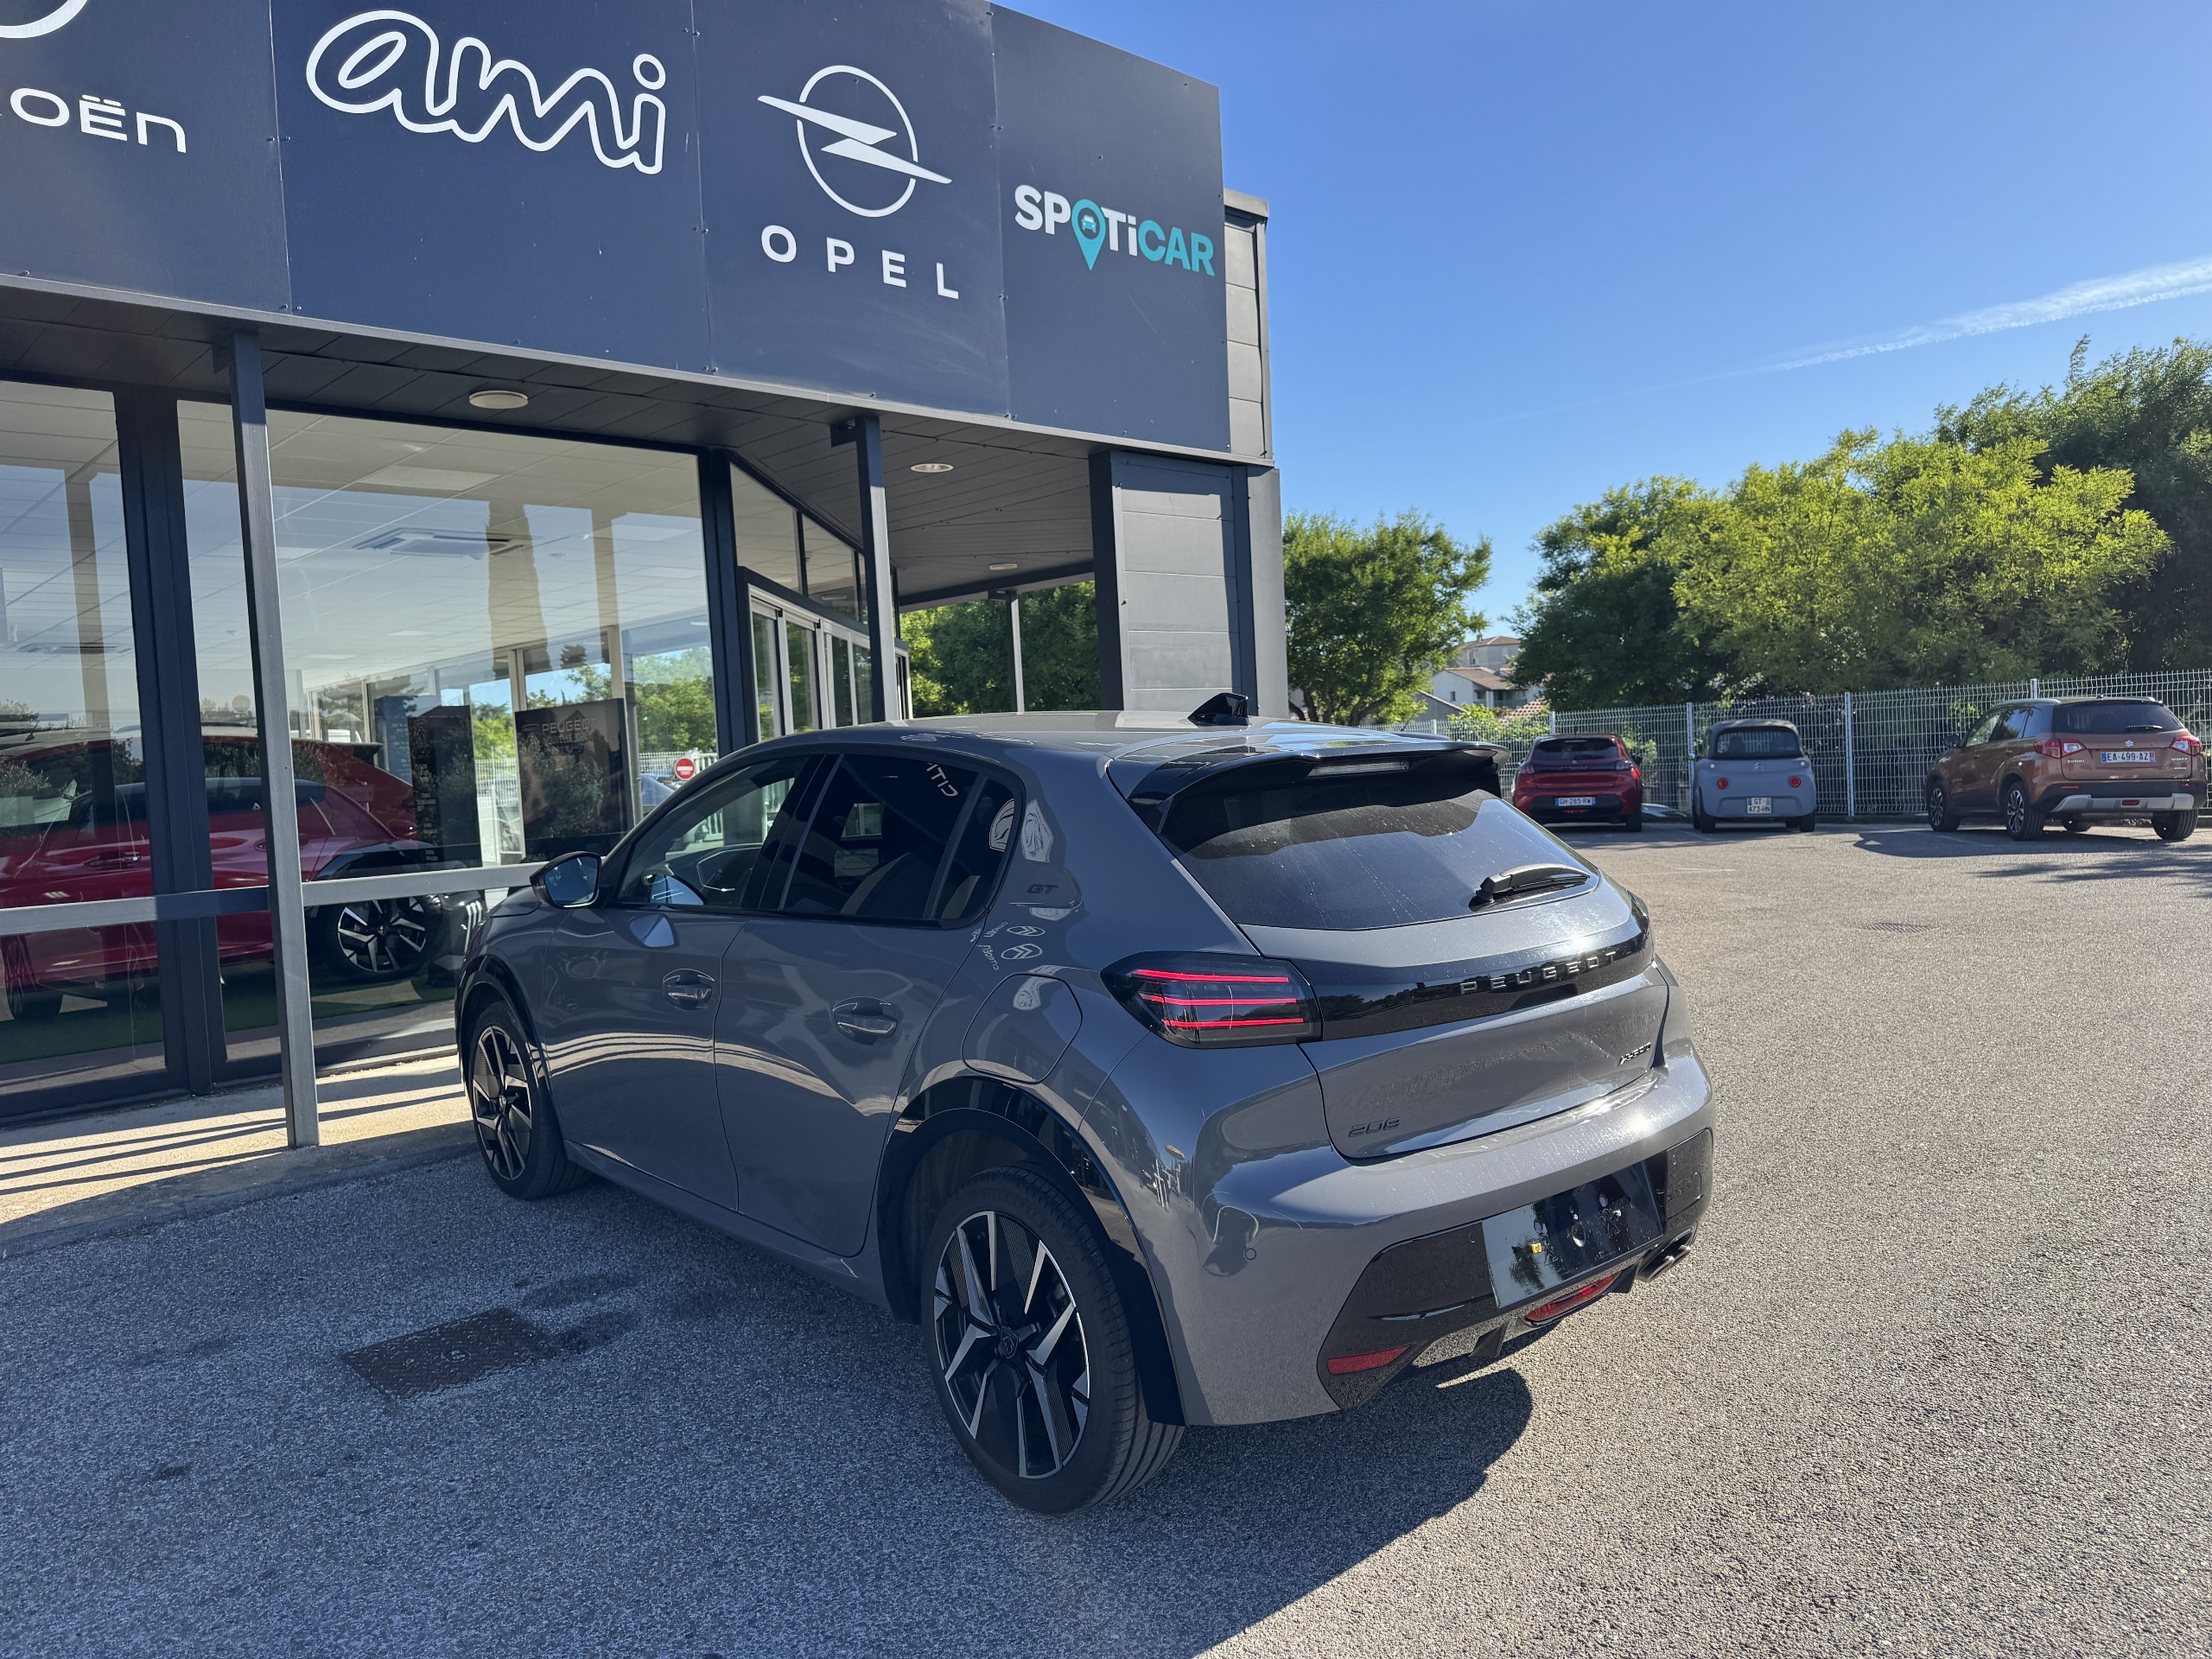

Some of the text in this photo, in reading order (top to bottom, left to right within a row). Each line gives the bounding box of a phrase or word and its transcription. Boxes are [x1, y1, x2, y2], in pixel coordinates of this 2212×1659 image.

[0, 87, 187, 154] OËN
[306, 10, 666, 175] ami
[761, 225, 959, 300] OPEL
[1027, 884, 1058, 894] GT
[1460, 951, 1616, 995] PEUGEOT
